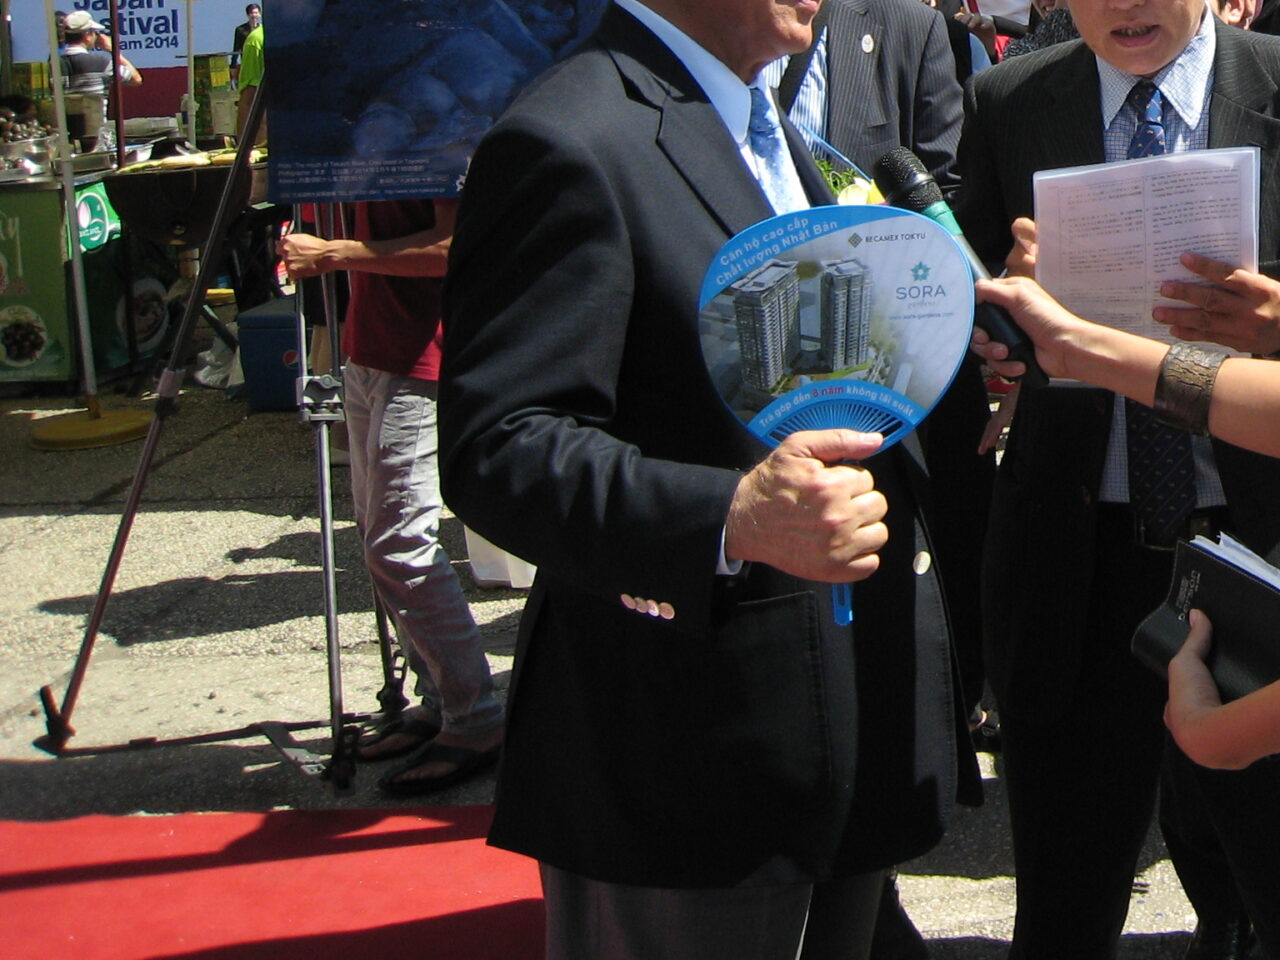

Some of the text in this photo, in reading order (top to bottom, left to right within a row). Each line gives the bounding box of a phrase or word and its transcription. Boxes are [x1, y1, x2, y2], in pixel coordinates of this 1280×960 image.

[145, 35, 179, 49] 2014
[762, 227, 784, 242] cao
[901, 233, 926, 241] TOKYU
[895, 284, 946, 301] SORA
